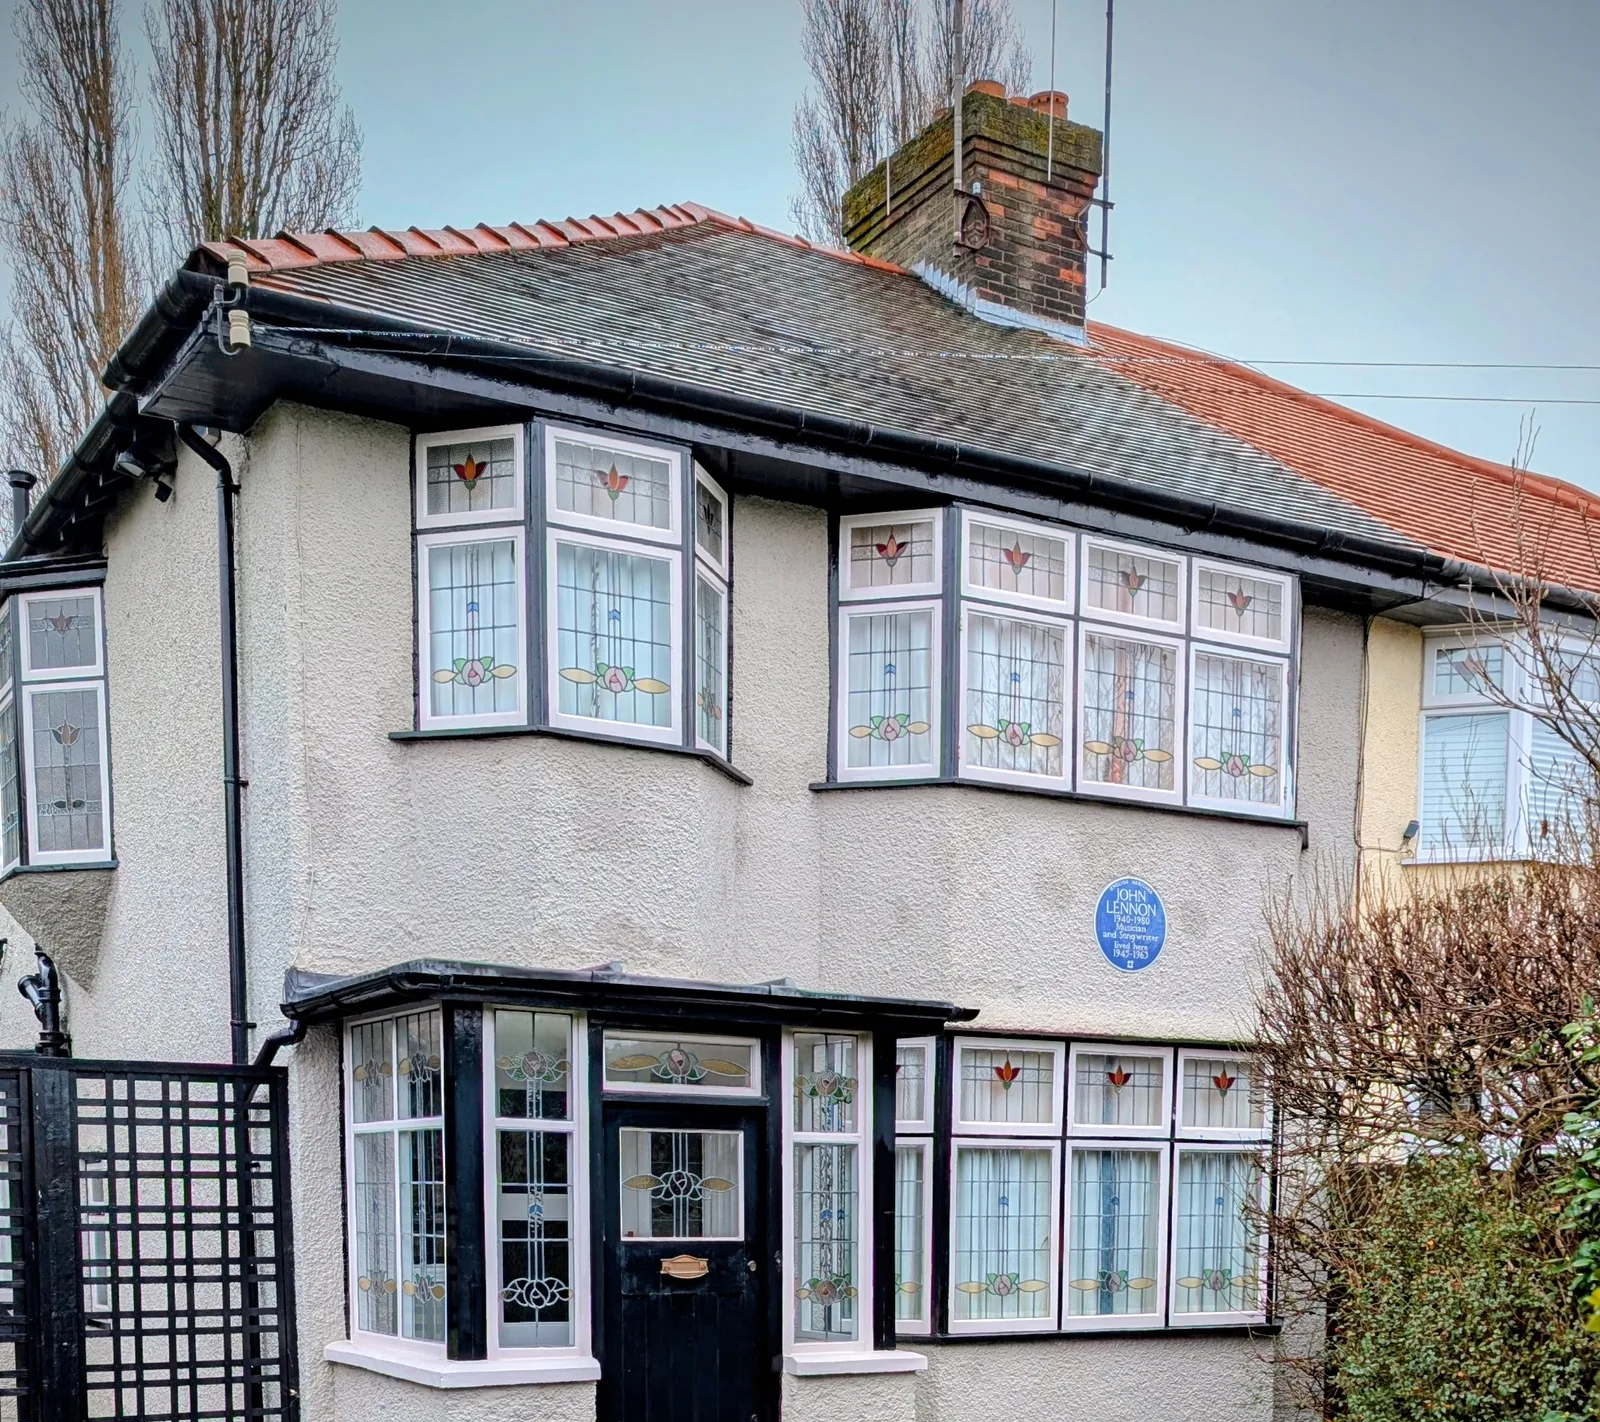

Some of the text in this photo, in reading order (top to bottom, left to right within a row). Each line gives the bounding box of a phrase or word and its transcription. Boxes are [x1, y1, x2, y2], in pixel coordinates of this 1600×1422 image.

[1116, 888, 1146, 902] JOHN
[1106, 900, 1156, 917] LENNON
[1113, 914, 1150, 925] 1940-1980
[1116, 922, 1147, 932] Musician
[1102, 930, 1159, 943] and Songwriter
[1114, 941, 1148, 951] lived here
[1113, 949, 1149, 960] 1945-1963
